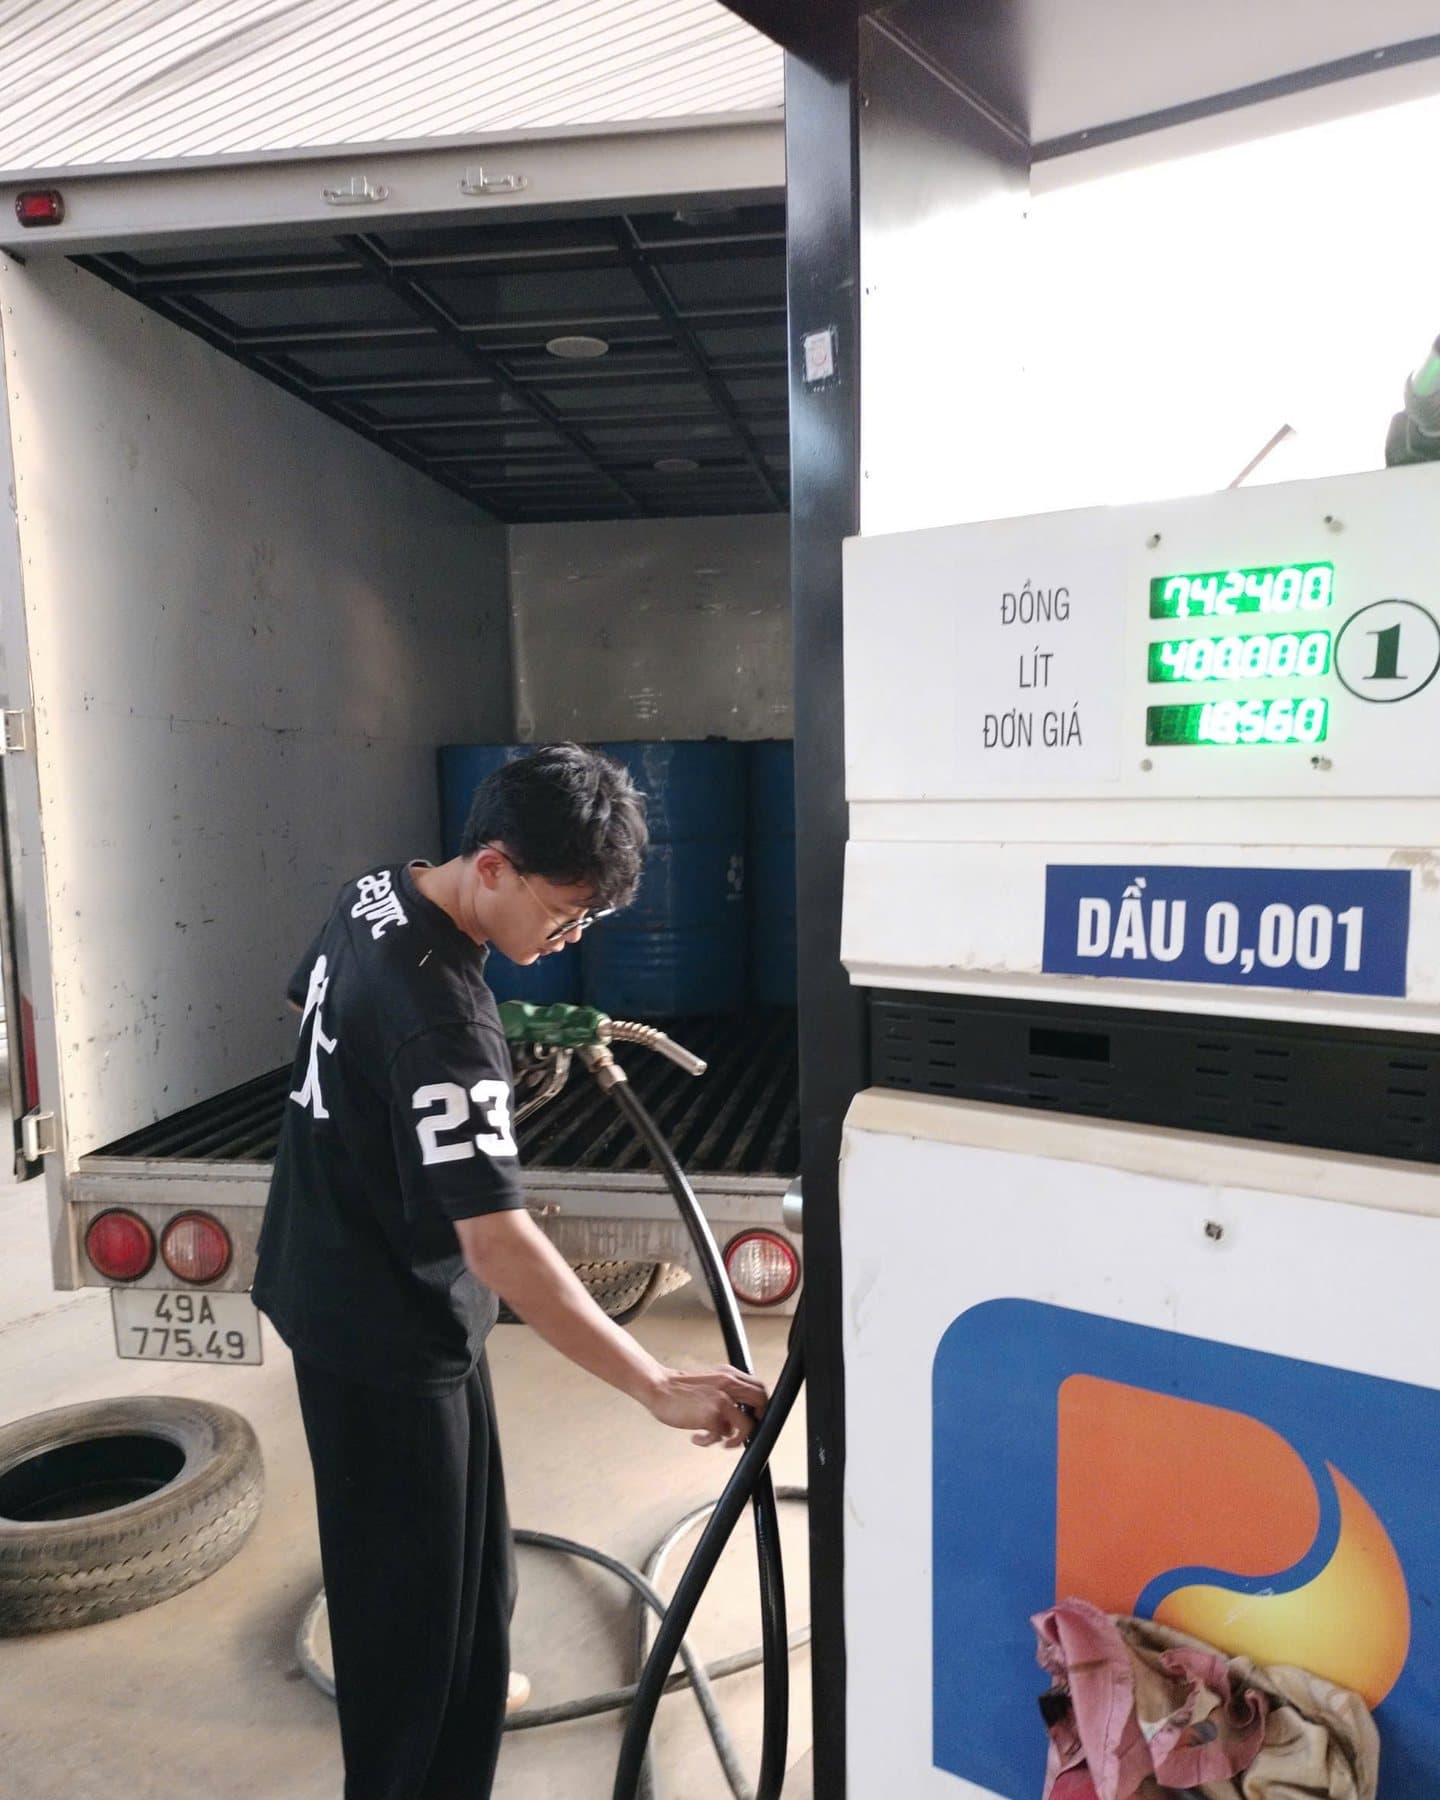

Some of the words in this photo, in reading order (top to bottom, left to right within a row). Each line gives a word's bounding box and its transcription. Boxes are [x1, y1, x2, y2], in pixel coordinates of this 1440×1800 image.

[1019, 645, 1054, 688] LÍT
[1362, 622, 1408, 679] 1
[983, 708, 1033, 748] ĐƠN
[1043, 701, 1082, 747] GIÁ
[1076, 876, 1186, 962] DẦU
[1204, 901, 1364, 974] 0,001
[412, 1079, 518, 1165] 23
[155, 1293, 216, 1325] 49A
[131, 1326, 245, 1360] 775.49
